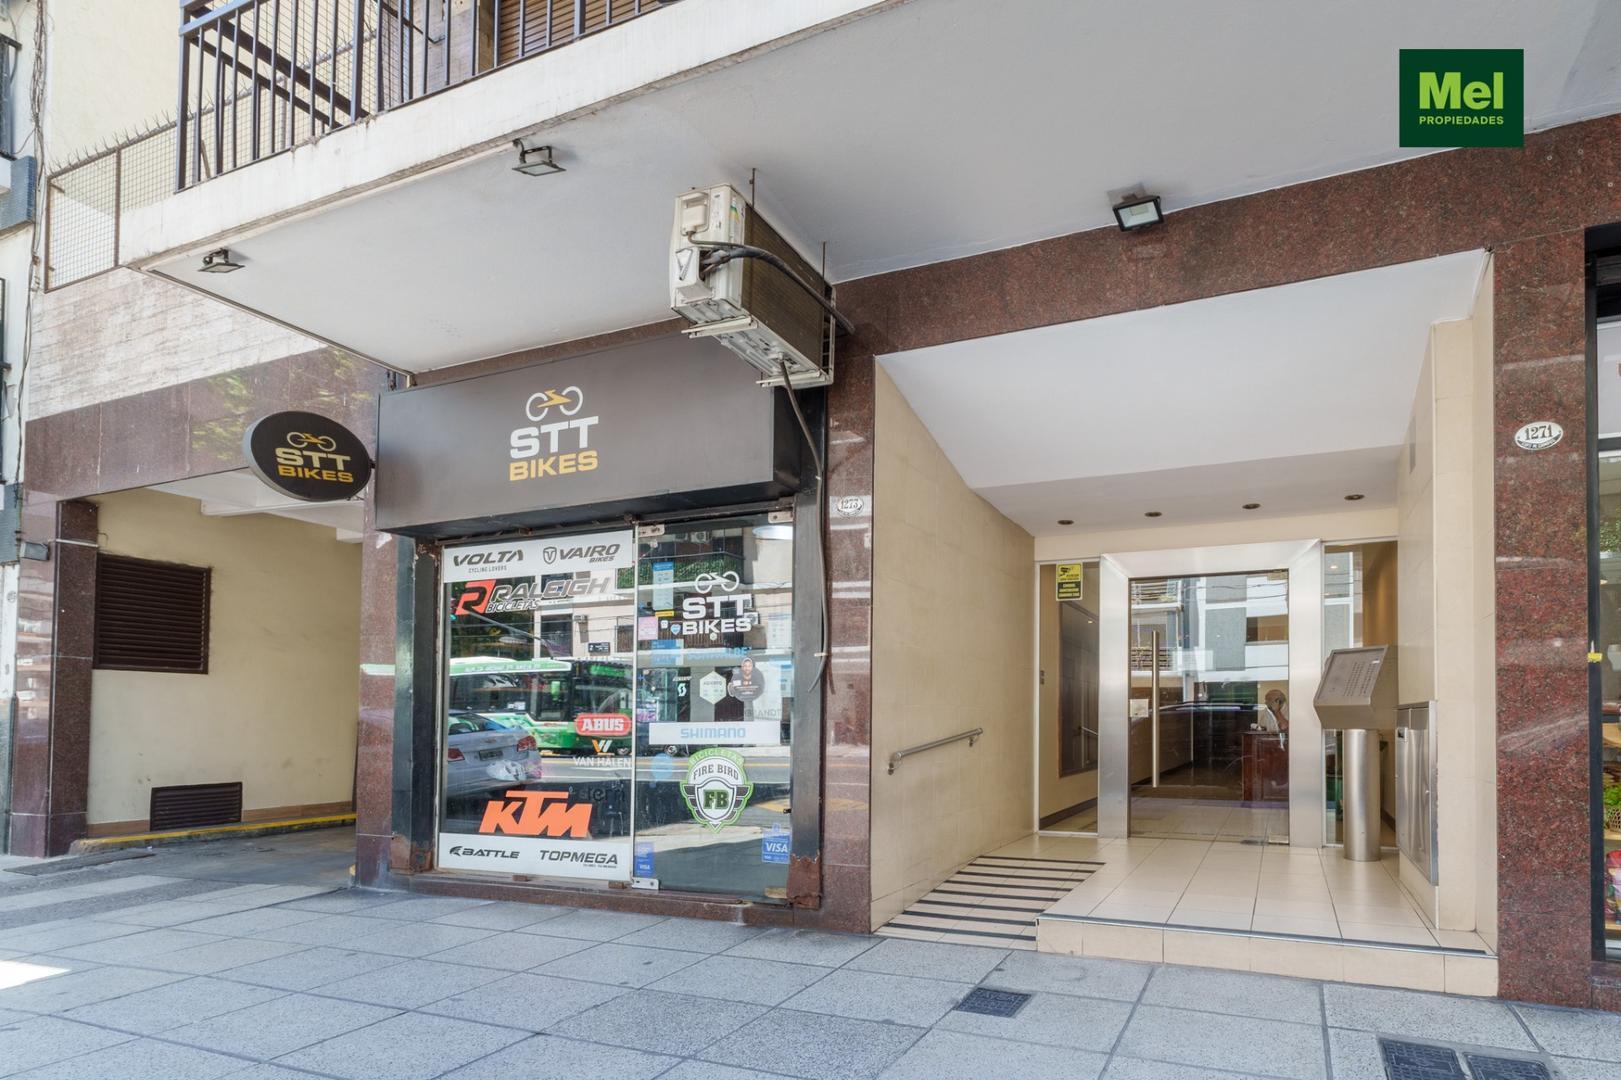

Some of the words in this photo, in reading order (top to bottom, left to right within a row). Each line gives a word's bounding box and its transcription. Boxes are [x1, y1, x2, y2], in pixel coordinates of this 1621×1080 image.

[510, 415, 599, 459] STT
[1525, 424, 1553, 441] 1271
[275, 447, 351, 471] STT
[509, 450, 598, 481] BIKES
[277, 464, 353, 483] BIKES
[453, 550, 524, 567] VOLTA
[559, 543, 621, 560] VAIRO
[490, 578, 610, 601] RALEIGH
[486, 600, 540, 613] BICICLETAS
[682, 594, 752, 620] STT
[682, 618, 752, 635] BIKES
[581, 718, 626, 732] ABUS
[680, 727, 746, 739] SHIMANO
[572, 756, 594, 767] VAN
[597, 757, 631, 768] HALEN
[693, 764, 715, 781] FIRE
[717, 763, 739, 781] BIRD
[703, 789, 730, 810] FB
[479, 790, 593, 838] KTM
[461, 848, 520, 859] BATTLE
[766, 842, 789, 853] VISA
[540, 850, 618, 865] TOPMEGA
